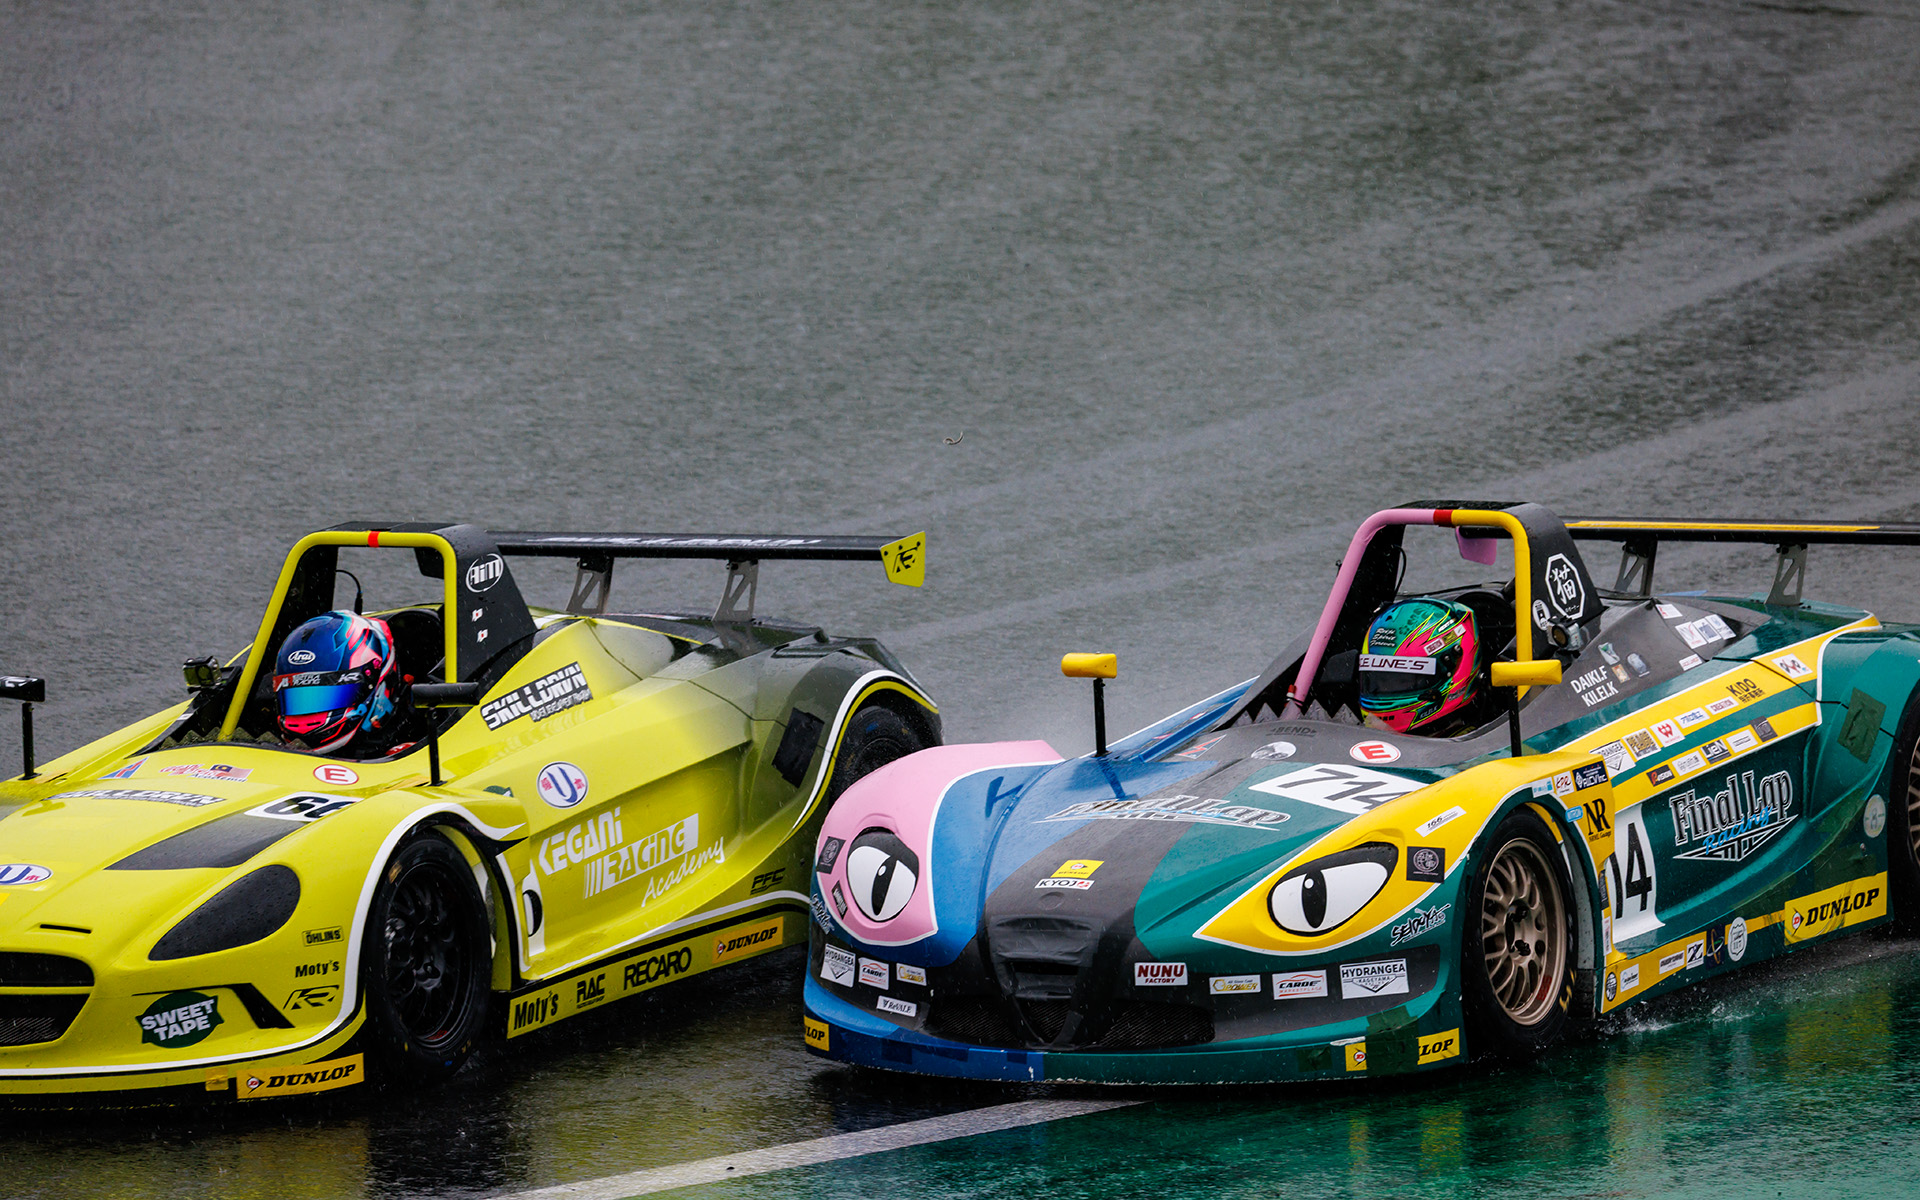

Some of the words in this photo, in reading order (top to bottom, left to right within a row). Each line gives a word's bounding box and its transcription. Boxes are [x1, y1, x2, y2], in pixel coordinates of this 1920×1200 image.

[1549, 564, 1577, 605] 猫
[291, 652, 312, 661] Arai
[1726, 678, 1757, 697] KIDO
[1359, 744, 1392, 760] E
[324, 768, 348, 782] E
[1669, 774, 1744, 846] Final
[1742, 770, 1793, 822] Lap
[1703, 805, 1773, 855] Racing
[641, 836, 726, 908] Academy
[1805, 888, 1880, 926] DUNLOP
[725, 926, 778, 952] DUNLOP
[295, 960, 339, 978] Moty's
[624, 947, 692, 990] RECARO
[1137, 964, 1185, 978] NUNU
[1341, 963, 1406, 978] HYDRANGEA
[576, 974, 606, 1003] RAC
[141, 999, 214, 1030] SWEET
[514, 991, 559, 1030] Moty's
[153, 1015, 211, 1041] TAPE
[806, 1027, 825, 1041] LOP
[1418, 1038, 1454, 1057] LOP
[266, 1064, 356, 1088] DUNLOP
